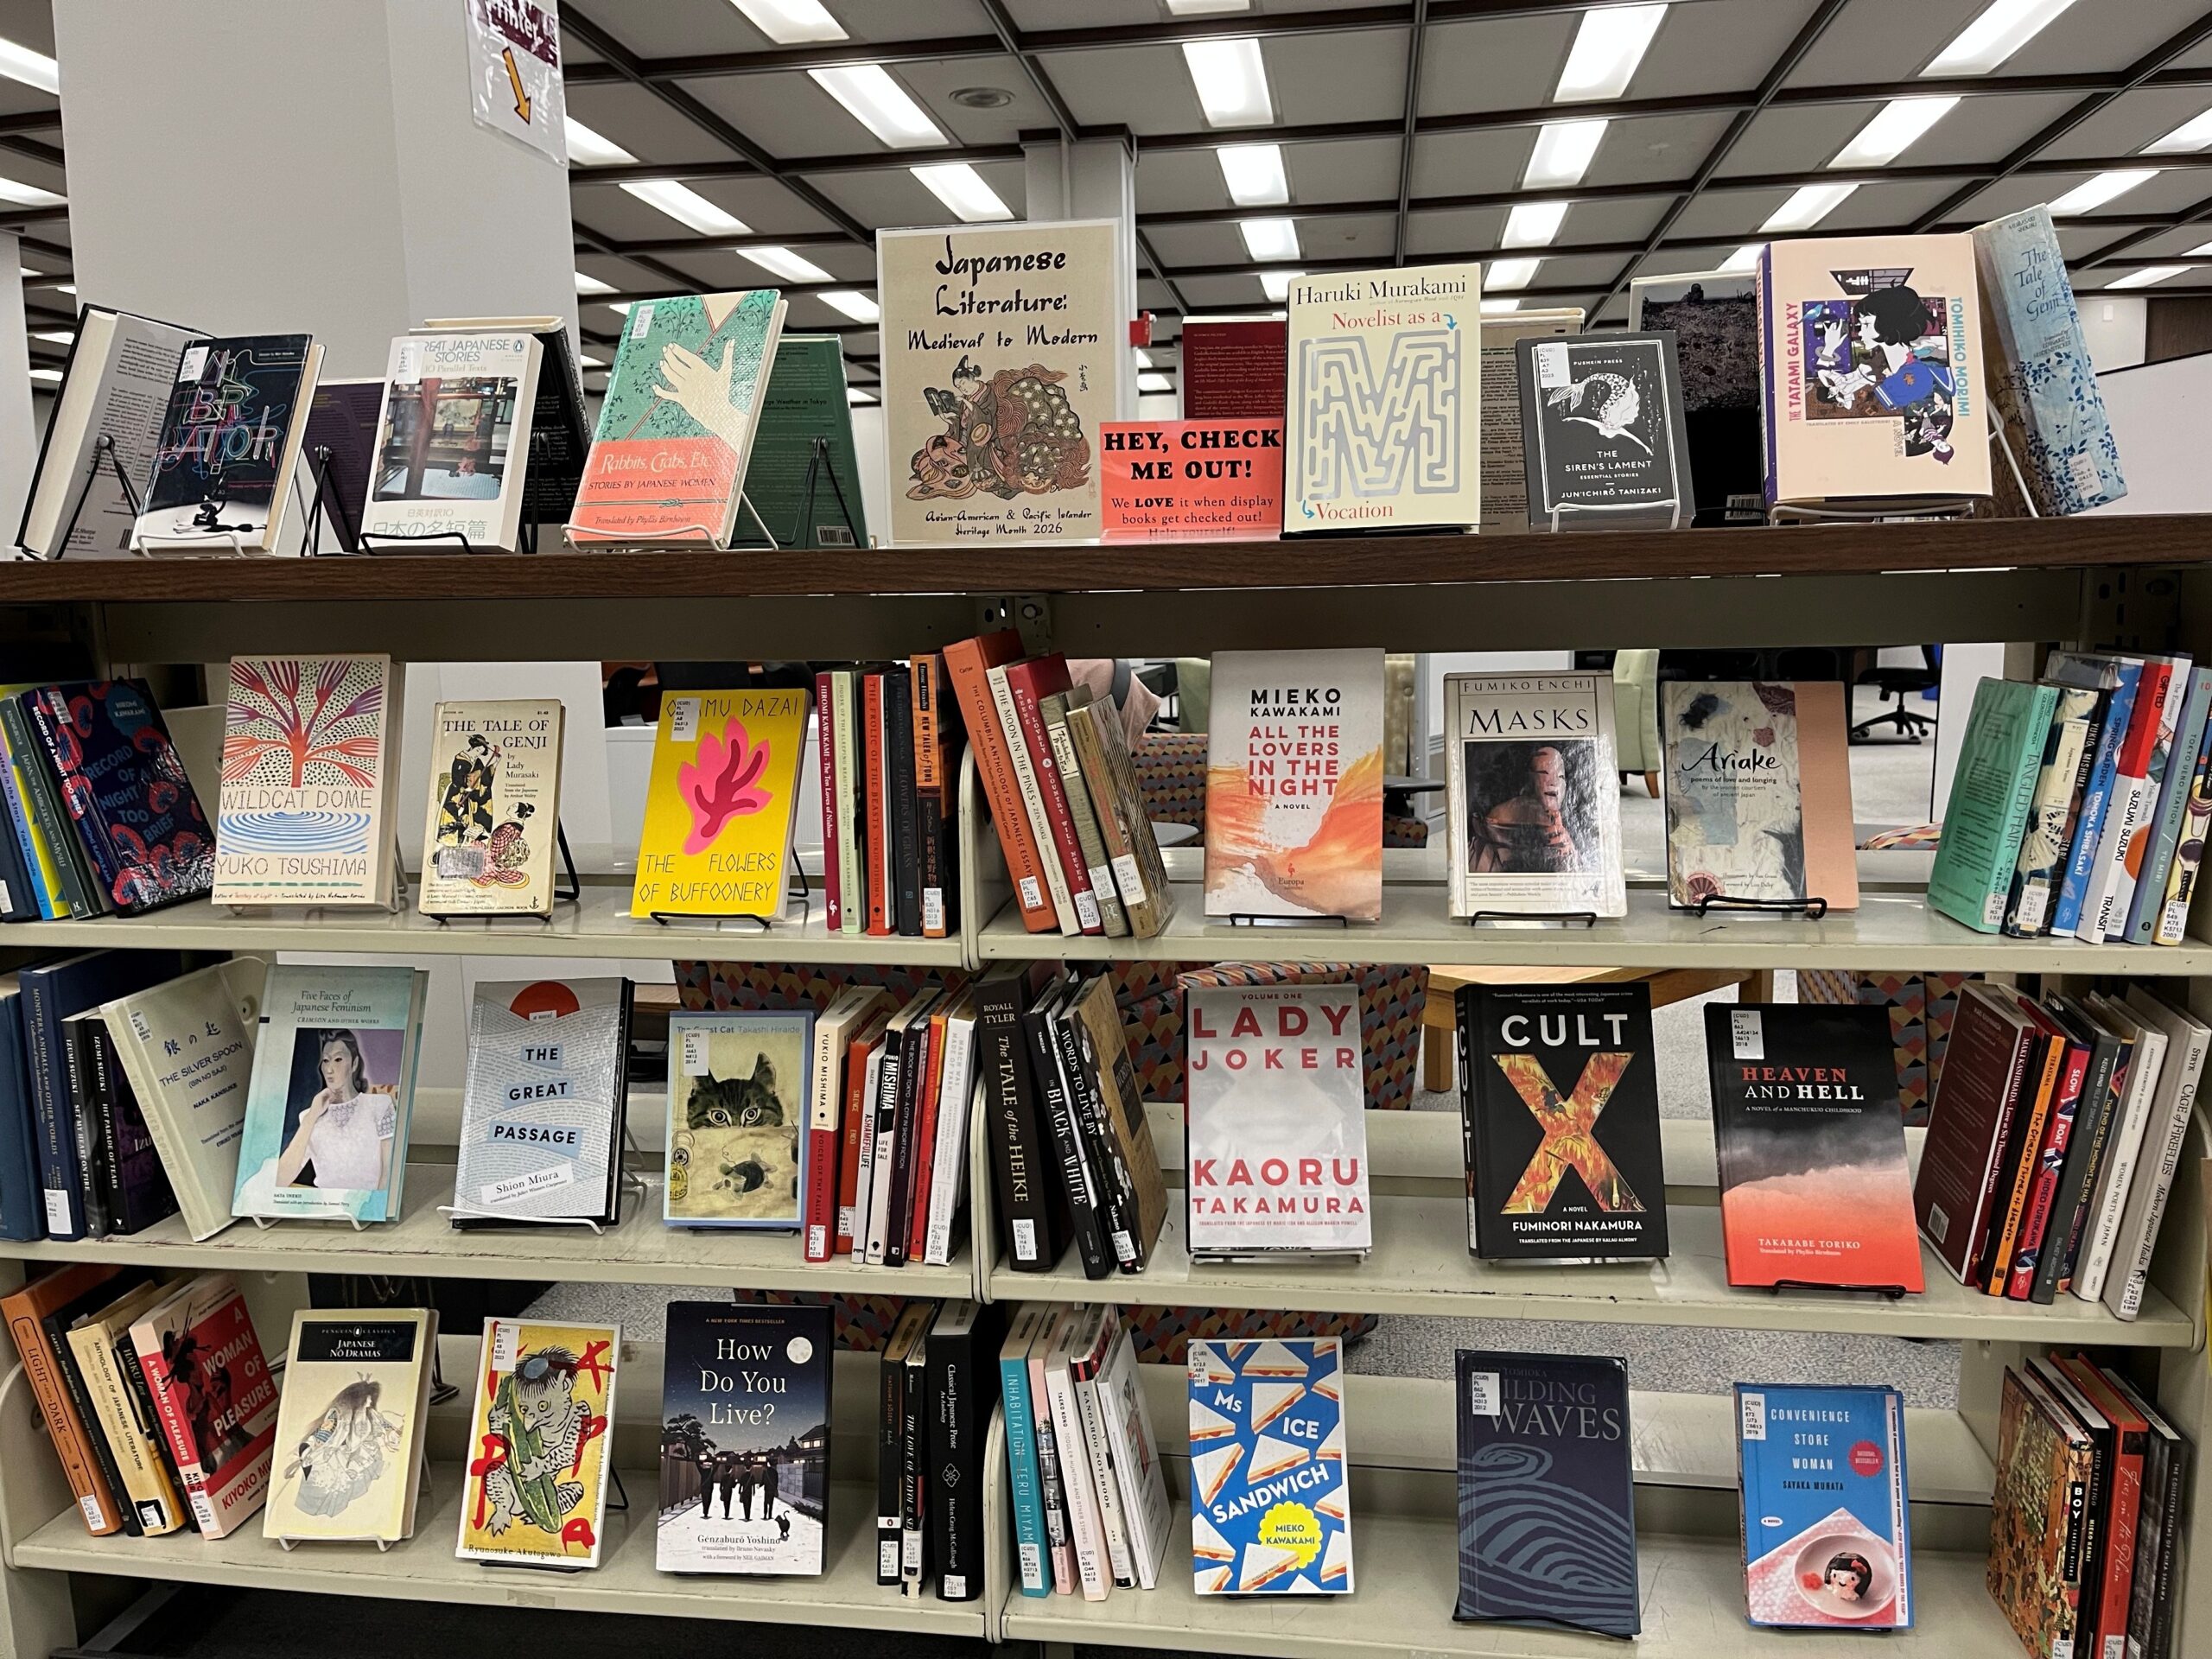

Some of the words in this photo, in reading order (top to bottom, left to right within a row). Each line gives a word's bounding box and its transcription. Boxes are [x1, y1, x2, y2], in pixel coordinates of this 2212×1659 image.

[935, 235, 1066, 286] Japanese
[2021, 249, 2047, 267] The
[2014, 268, 2043, 288] Tale
[936, 284, 1067, 315] Literature:
[1296, 283, 1361, 305] Haruki
[1369, 275, 1466, 299] Murakami
[2035, 280, 2046, 299] of
[2026, 294, 2060, 321] Genji
[1332, 309, 1401, 330] Novelist
[1408, 315, 1426, 324] as
[1432, 314, 1441, 322] a
[1786, 302, 1800, 357] GALAXY
[1950, 296, 1967, 362] TOMIHIKO
[448, 339, 511, 352] JAPANESE
[908, 329, 984, 350] Medieval
[997, 331, 1013, 346] to
[1027, 325, 1097, 346] Modern
[435, 352, 480, 363] STORIES
[1788, 360, 1801, 406] TATAMI
[1955, 365, 1970, 416] MORIMI
[1789, 410, 1802, 422] THE
[1104, 431, 1169, 454] HEY,
[1180, 429, 1281, 449] CHECK
[601, 454, 647, 474] Rabbits,
[651, 450, 688, 473] Crabs,
[1130, 461, 1173, 480] ME
[1185, 460, 1252, 479] OUT!
[1565, 463, 1605, 472] SIREN'S
[1608, 461, 1652, 470] LAMENT
[588, 480, 621, 491] STORIES
[623, 480, 634, 489] BY
[637, 479, 677, 489] JAPANESE
[680, 477, 716, 487] WOMEN
[1111, 498, 1129, 508] We
[1135, 498, 1173, 508] LOVE
[1180, 498, 1188, 507] it
[1194, 496, 1225, 507] when
[1230, 495, 1274, 508] display
[1315, 500, 1394, 521] Vocation
[925, 508, 1000, 522] Asian-American
[1007, 510, 1015, 519] &
[1023, 509, 1051, 522] Pacific
[1058, 508, 1092, 519] Islander
[1122, 513, 1156, 524] books
[1161, 515, 1179, 525] get
[1184, 512, 1232, 523] checked
[1236, 512, 1262, 522] out!
[955, 524, 990, 537] Heritage
[996, 524, 1027, 535] Month
[1033, 523, 1063, 535] 2026
[1464, 681, 1530, 693] FUMIKO
[1537, 679, 1592, 691] ENCHI
[2155, 675, 2170, 709] GIFTED
[1251, 688, 1342, 705] MIEKO
[742, 697, 798, 717] DAZAI
[1250, 706, 1340, 717] KAWAKAMI
[442, 720, 476, 733] THE
[483, 720, 522, 732] TALE
[529, 720, 550, 731] OF
[1003, 709, 1019, 739] MOON
[1469, 709, 1589, 734] MASKS
[1249, 726, 1288, 739] ALL
[1298, 725, 1339, 738] THE
[502, 736, 547, 749] GENJI
[1012, 739, 1020, 752] IN
[1249, 741, 1338, 756] LOVERS
[506, 761, 524, 770] Lady
[1015, 753, 1028, 773] THE
[1681, 742, 1783, 772] Ariake
[505, 770, 539, 779] Murasaki
[1248, 760, 1275, 776] IN
[1287, 760, 1338, 776] THE
[1020, 774, 1037, 801] PINES
[1247, 779, 1338, 797] NIGHT
[221, 790, 308, 810] WILDCAT
[316, 790, 372, 810] DOME
[2124, 790, 2141, 826] SUZUMI
[2115, 828, 2131, 861] SUZUKI
[216, 856, 268, 875] YUKO
[277, 857, 367, 875] TSUSHIMA
[645, 854, 676, 874] THE
[709, 852, 776, 872] FLOWERS
[639, 883, 659, 902] OF
[670, 881, 774, 902] BUFFOONERY
[301, 990, 318, 1001] Five
[319, 990, 341, 1001] Faces
[343, 989, 354, 1002] of
[290, 1001, 329, 1014] Japanese
[331, 1001, 372, 1013] Feminism
[983, 1002, 1014, 1012] ROYALL
[984, 1013, 1016, 1024] TYLER
[1192, 1005, 1352, 1039] LADY
[1501, 1014, 1629, 1047] CULT
[159, 1071, 181, 1087] THE
[181, 1055, 213, 1077] SILVER
[212, 1040, 243, 1062] SPOON
[524, 1047, 559, 1061] THE
[1192, 1047, 1356, 1071] JOKER
[999, 1058, 1018, 1106] TALE
[1742, 1066, 1847, 1083] HEAVEN
[508, 1082, 569, 1101] GREAT
[1745, 1085, 1790, 1099] AND
[1796, 1084, 1865, 1100] HELL
[1004, 1109, 1017, 1122] of
[493, 1125, 577, 1145] PASSAGE
[1006, 1122, 1018, 1141] the
[1491, 1051, 1647, 1214] X
[1008, 1144, 1029, 1203] HEIKE
[1193, 1158, 1359, 1186] KAORU
[495, 1178, 525, 1196] Shion
[529, 1169, 560, 1188] Miura
[1192, 1197, 1365, 1214] TAKAMURA
[1512, 1221, 1572, 1231] FUMINORI
[1574, 1220, 1643, 1230] NAKAMURA
[1758, 1238, 1816, 1248] TAKARABE
[1818, 1240, 1861, 1249] TORIKO
[202, 1331, 255, 1377] WOMAN
[336, 1339, 376, 1349] JAPANESE
[346, 1349, 381, 1357] DRAMAS
[716, 1338, 773, 1361] How
[700, 1370, 734, 1393] Do
[741, 1370, 786, 1393] You
[213, 1380, 273, 1437] PLEASURE
[1214, 1389, 1243, 1413] Ms
[710, 1402, 775, 1426] Live?
[1490, 1402, 1621, 1440] WAVES
[1770, 1408, 1851, 1423] CONVENIENCE
[1282, 1417, 1319, 1440] ICE
[1794, 1433, 1829, 1446] STORE
[1792, 1458, 1834, 1471] WOMAN
[221, 1471, 257, 1510] KIYOKO
[1212, 1462, 1330, 1523] SANDWICH
[1783, 1480, 1811, 1490] SAYAKA
[1814, 1481, 1844, 1491] MURATA
[1275, 1524, 1305, 1533] MIEKO
[468, 1544, 513, 1556] Ryunosuke
[1266, 1536, 1315, 1545] KAWAKAMI
